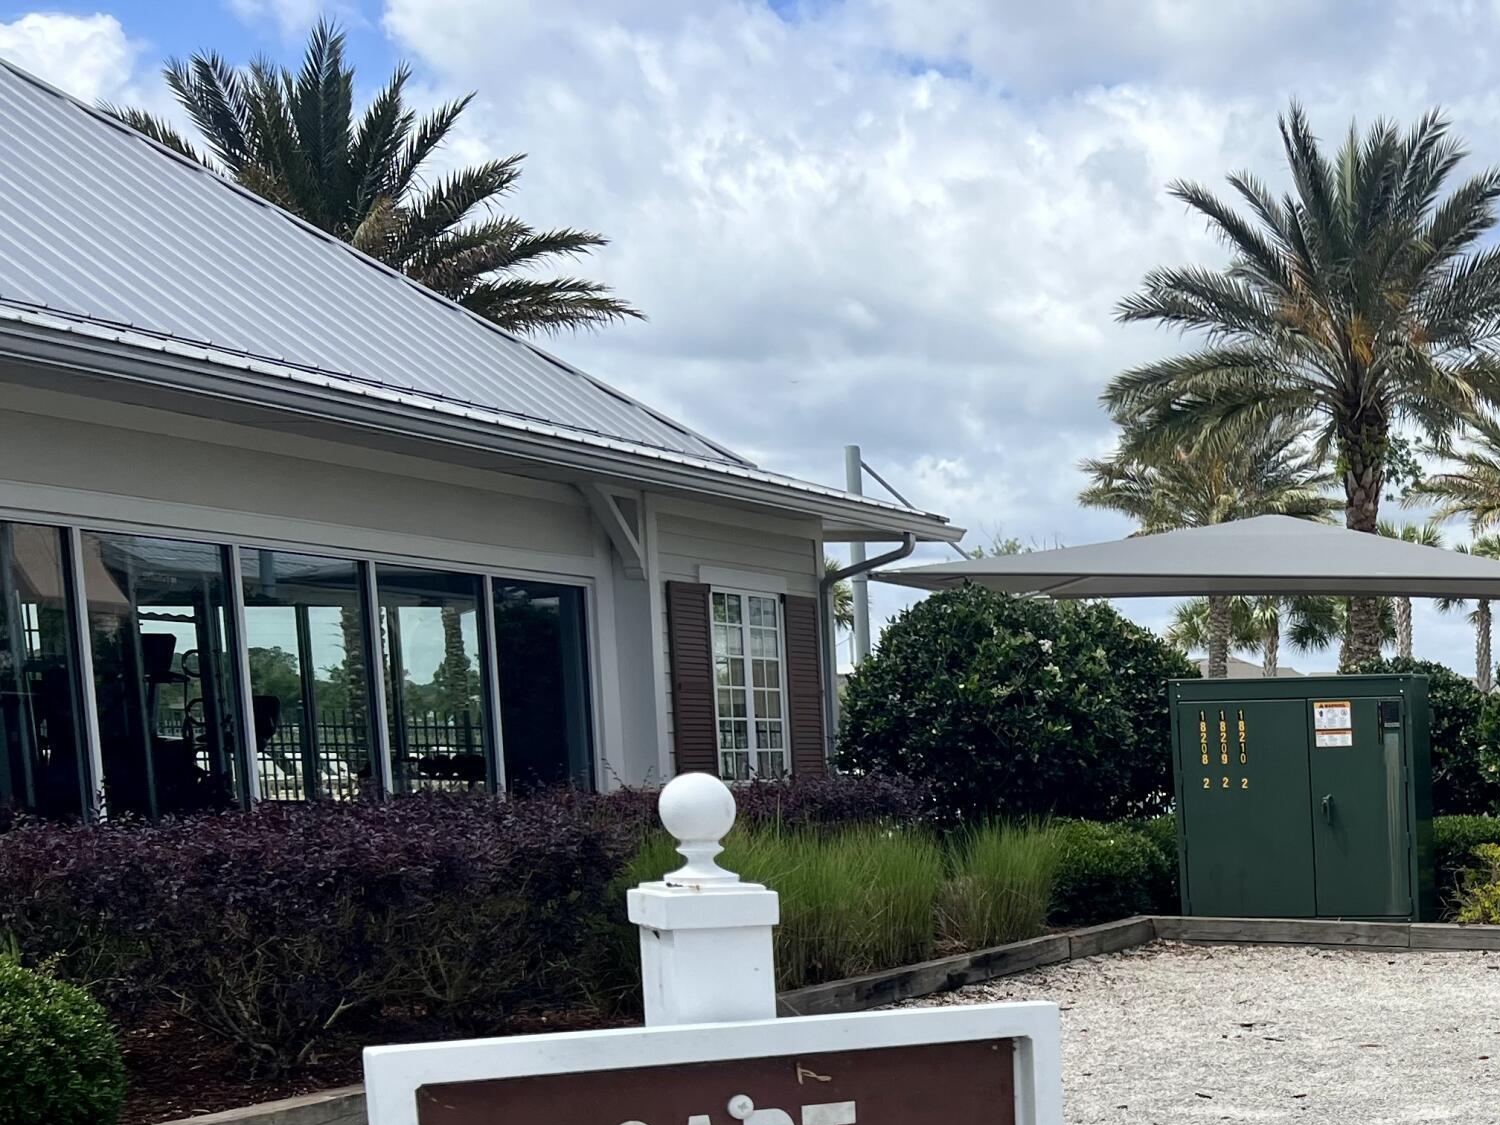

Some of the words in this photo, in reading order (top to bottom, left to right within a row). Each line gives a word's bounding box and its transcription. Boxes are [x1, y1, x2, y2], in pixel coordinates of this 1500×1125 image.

[1199, 709, 1209, 765] 18208
[1219, 709, 1228, 765] 18209
[1203, 777, 1210, 789] 2
[1222, 776, 1229, 788] 2
[1241, 778, 1248, 789] 2
